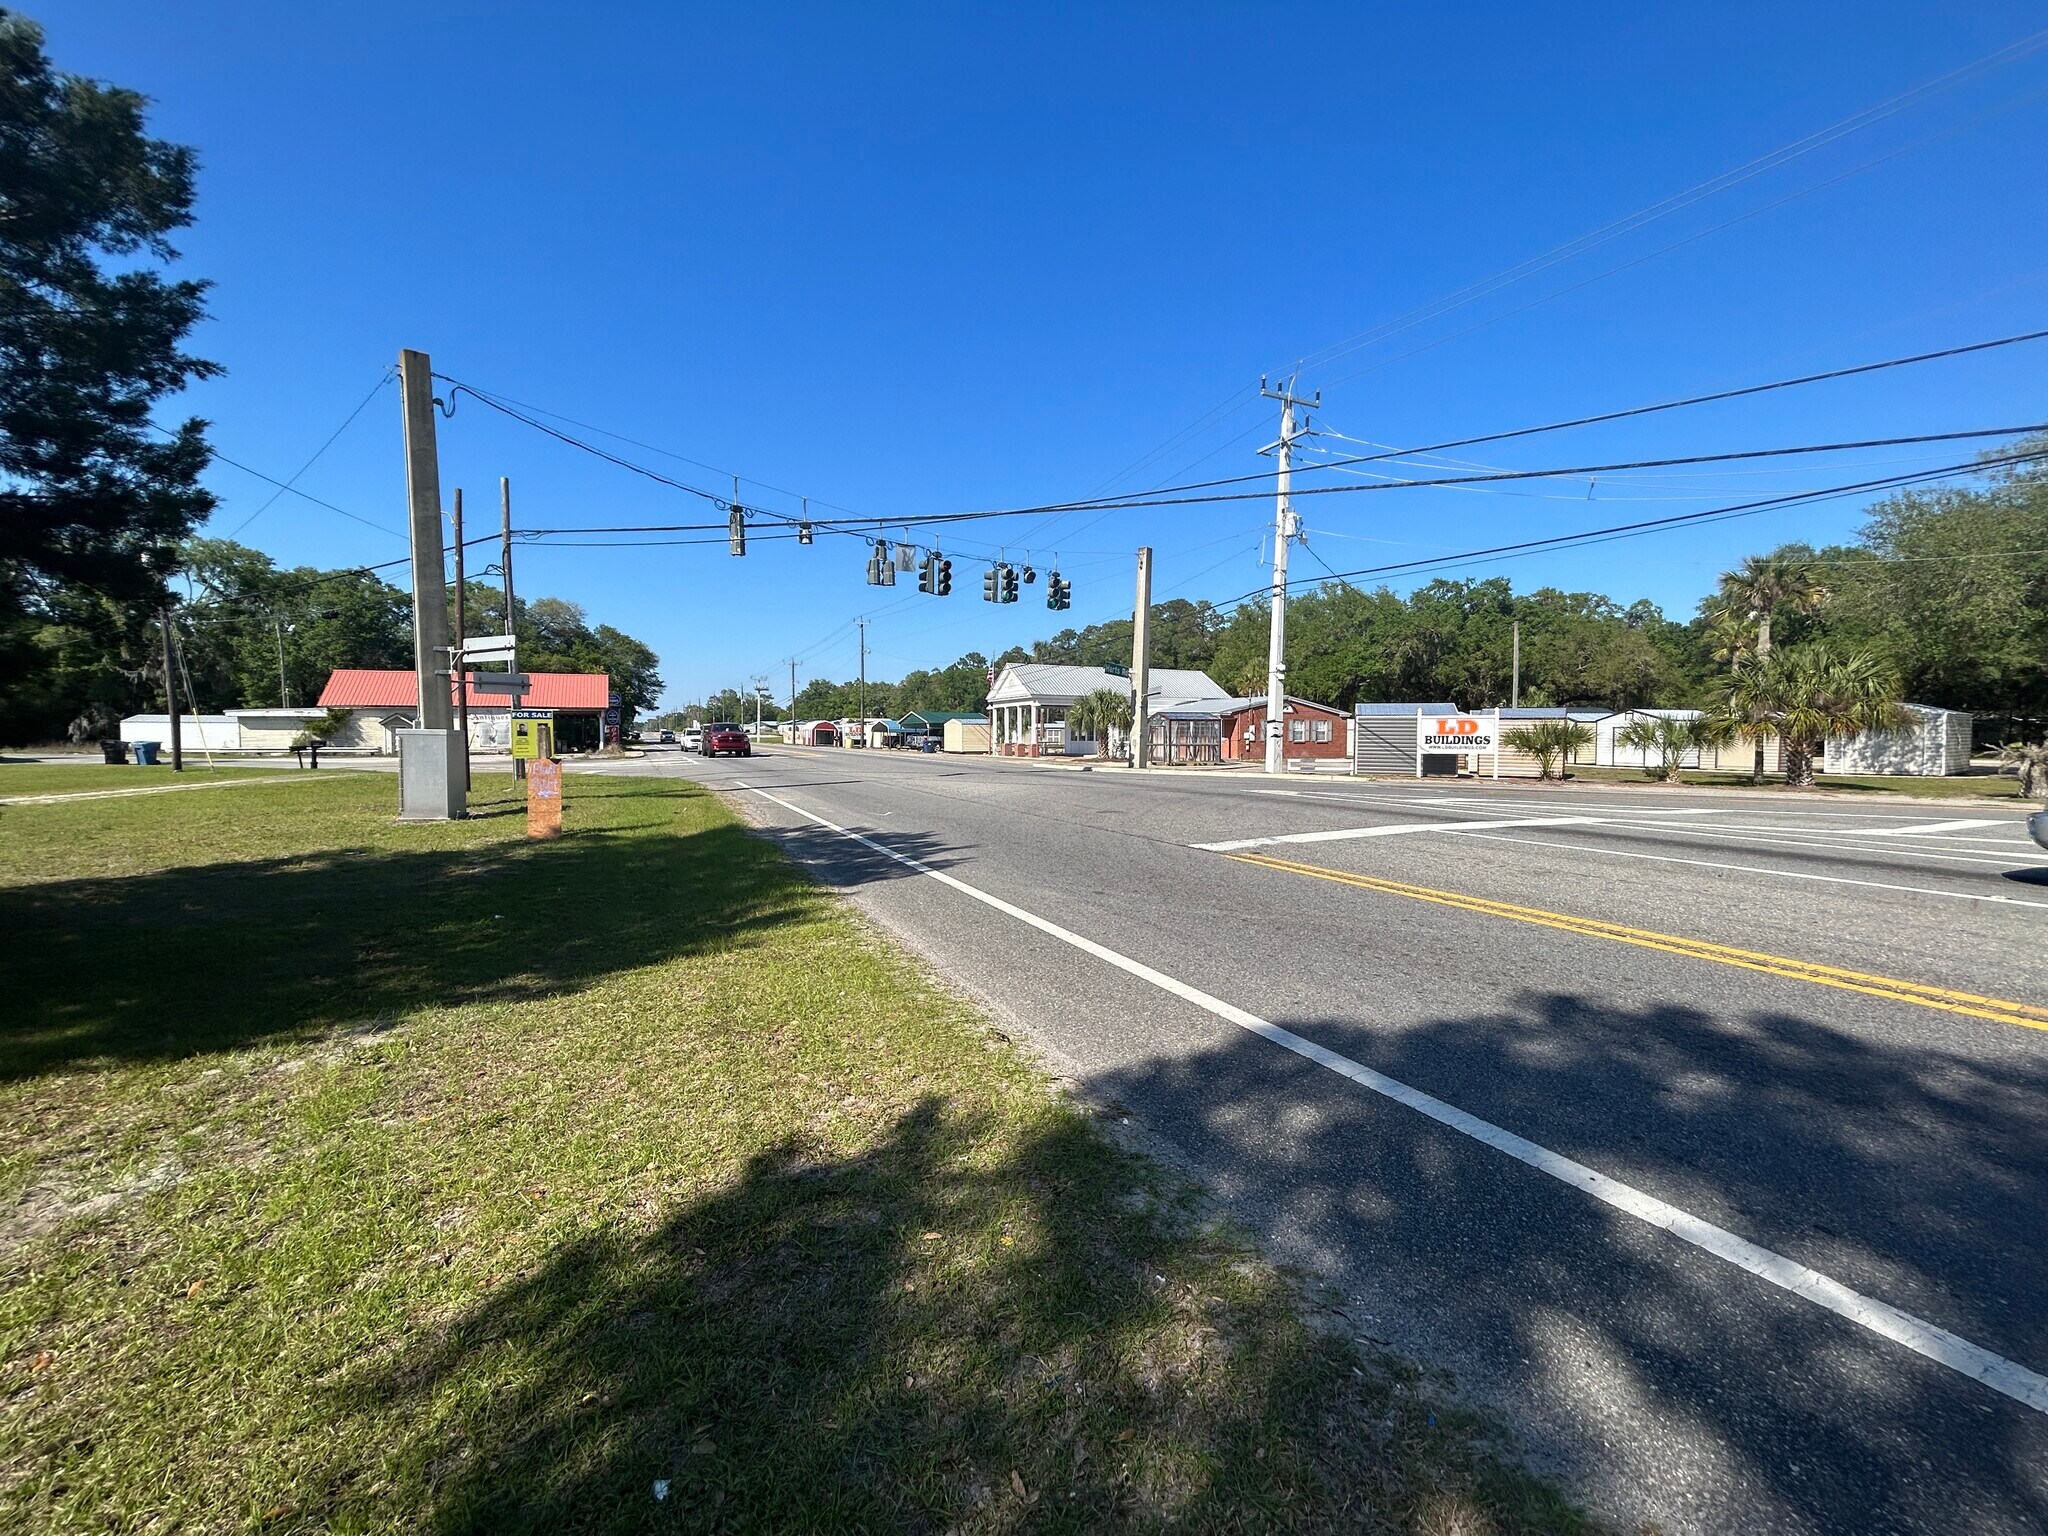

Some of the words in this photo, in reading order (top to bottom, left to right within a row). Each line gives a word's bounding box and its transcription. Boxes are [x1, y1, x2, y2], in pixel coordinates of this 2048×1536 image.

[1106, 665, 1120, 674] Harts
[1436, 719, 1479, 735] LD
[1424, 735, 1491, 745] BUILDINGS
